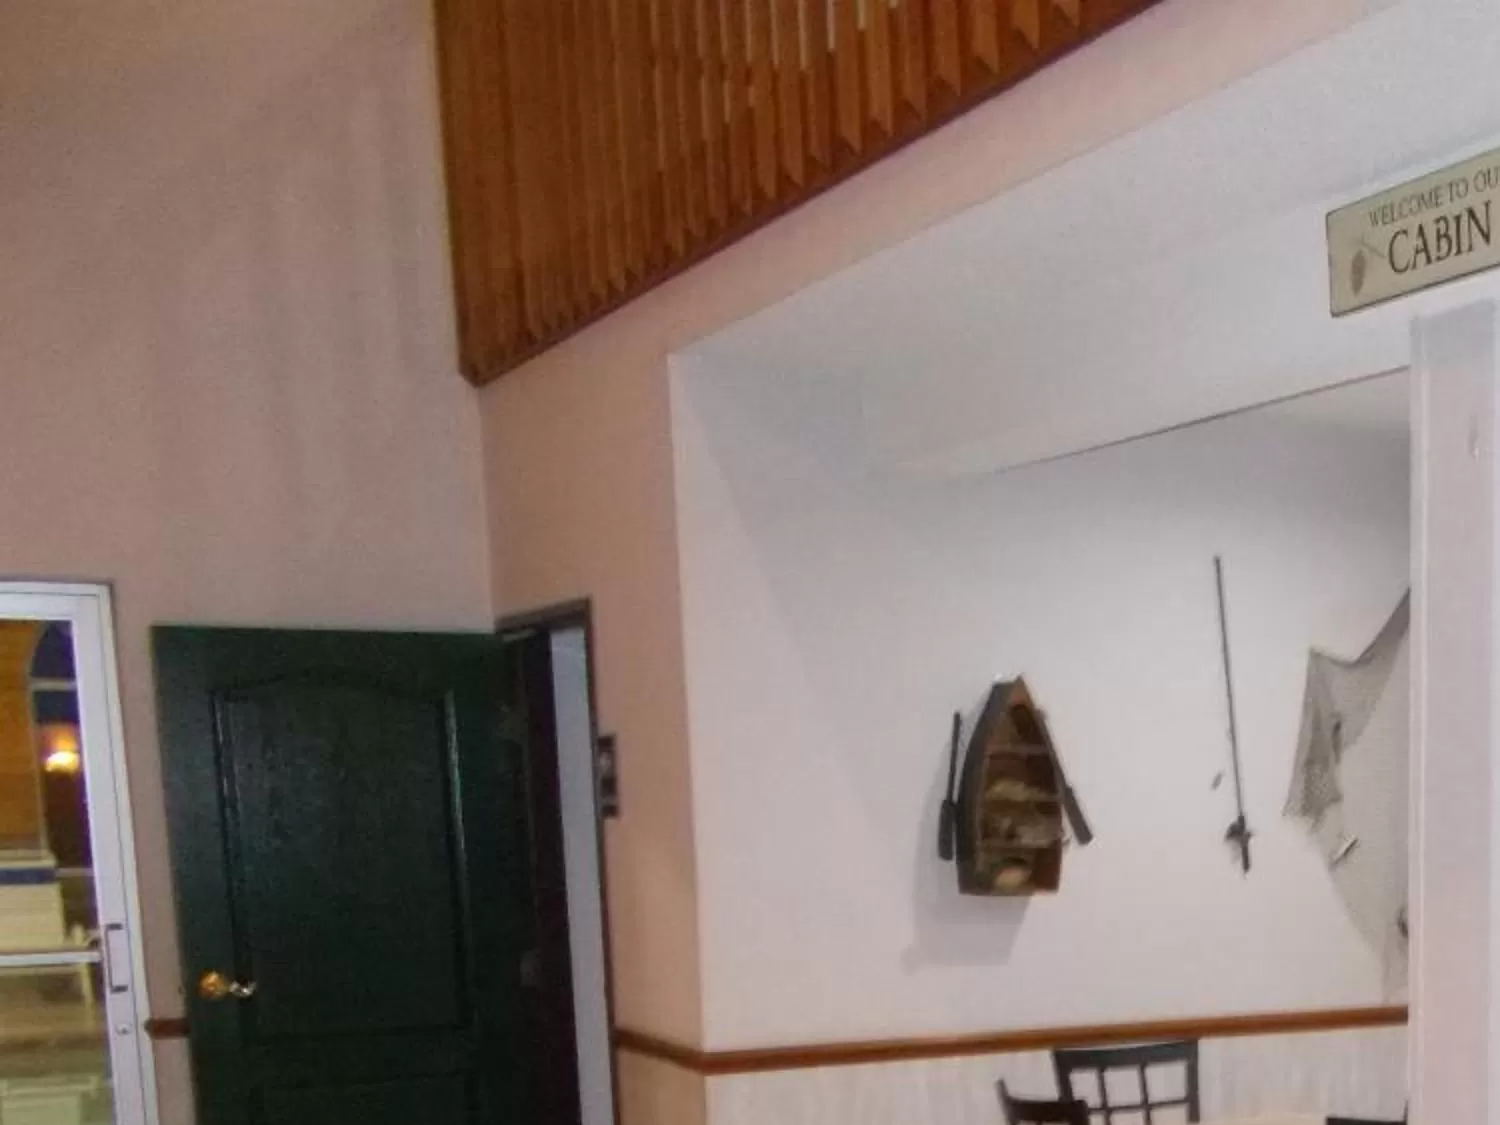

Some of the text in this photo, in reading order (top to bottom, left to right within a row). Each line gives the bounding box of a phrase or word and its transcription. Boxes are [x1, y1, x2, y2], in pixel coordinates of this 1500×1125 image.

[1368, 185, 1442, 227] WELCOME
[1448, 177, 1468, 204] TO
[1388, 199, 1492, 274] CABIN
